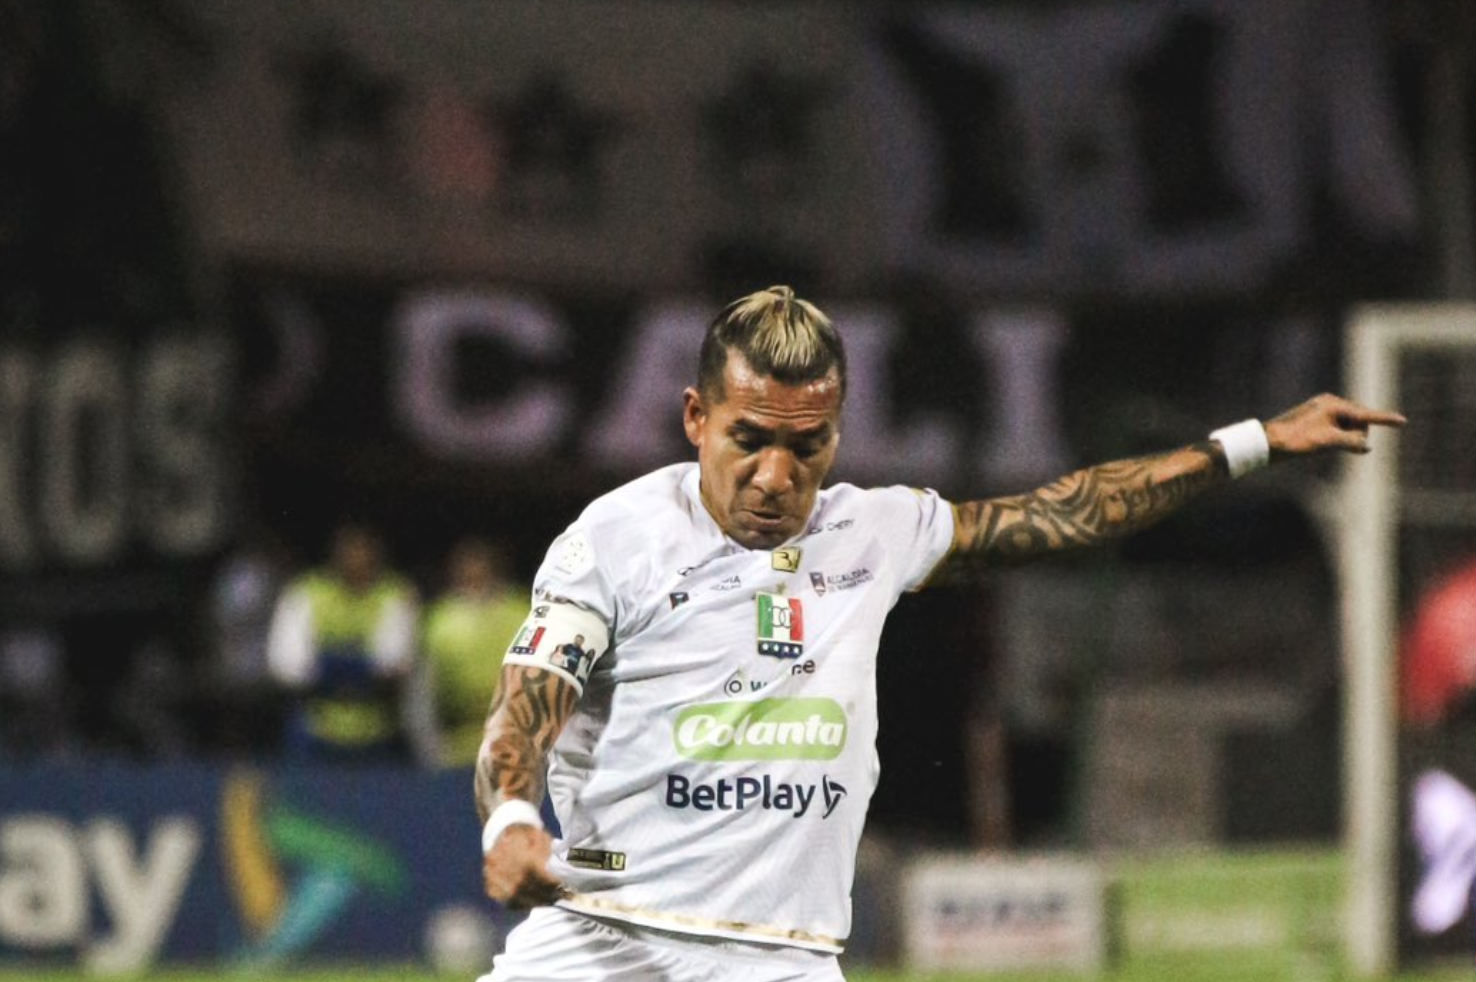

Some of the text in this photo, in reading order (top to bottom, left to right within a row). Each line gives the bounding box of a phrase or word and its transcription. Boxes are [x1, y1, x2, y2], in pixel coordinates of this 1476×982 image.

[0, 328, 224, 570] OS
[677, 713, 845, 749] Colanta
[665, 773, 817, 819] BetPlay
